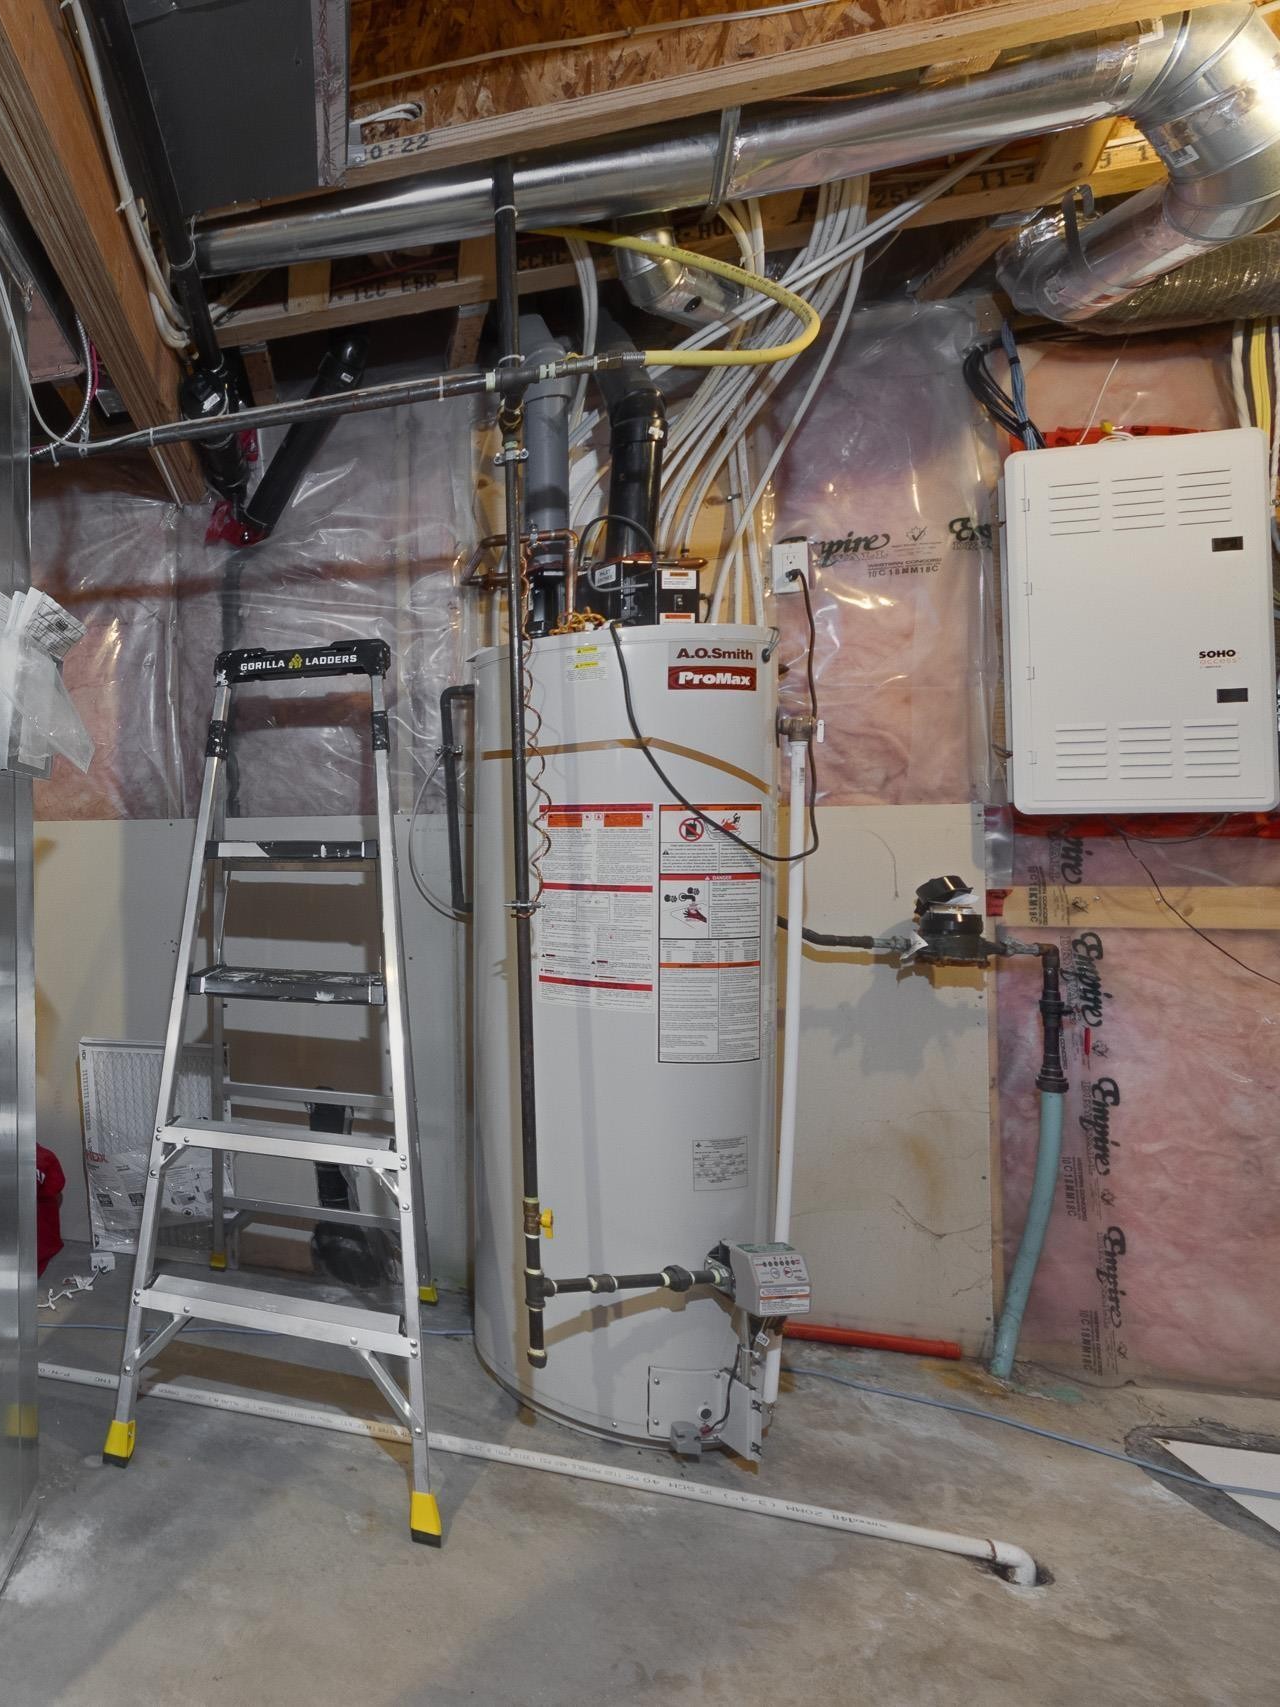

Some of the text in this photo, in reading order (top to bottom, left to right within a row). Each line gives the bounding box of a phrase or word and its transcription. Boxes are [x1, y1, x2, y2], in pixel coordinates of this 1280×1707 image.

[1199, 649, 1236, 658] SOHO
[240, 654, 357, 671] GORILLA LADDERS
[678, 671, 751, 685] ProMax
[1061, 932, 1113, 1028] Empire
[1079, 1077, 1121, 1176] Empire
[1096, 1227, 1127, 1328] Empire
[783, 1504, 823, 1518] 20MM
